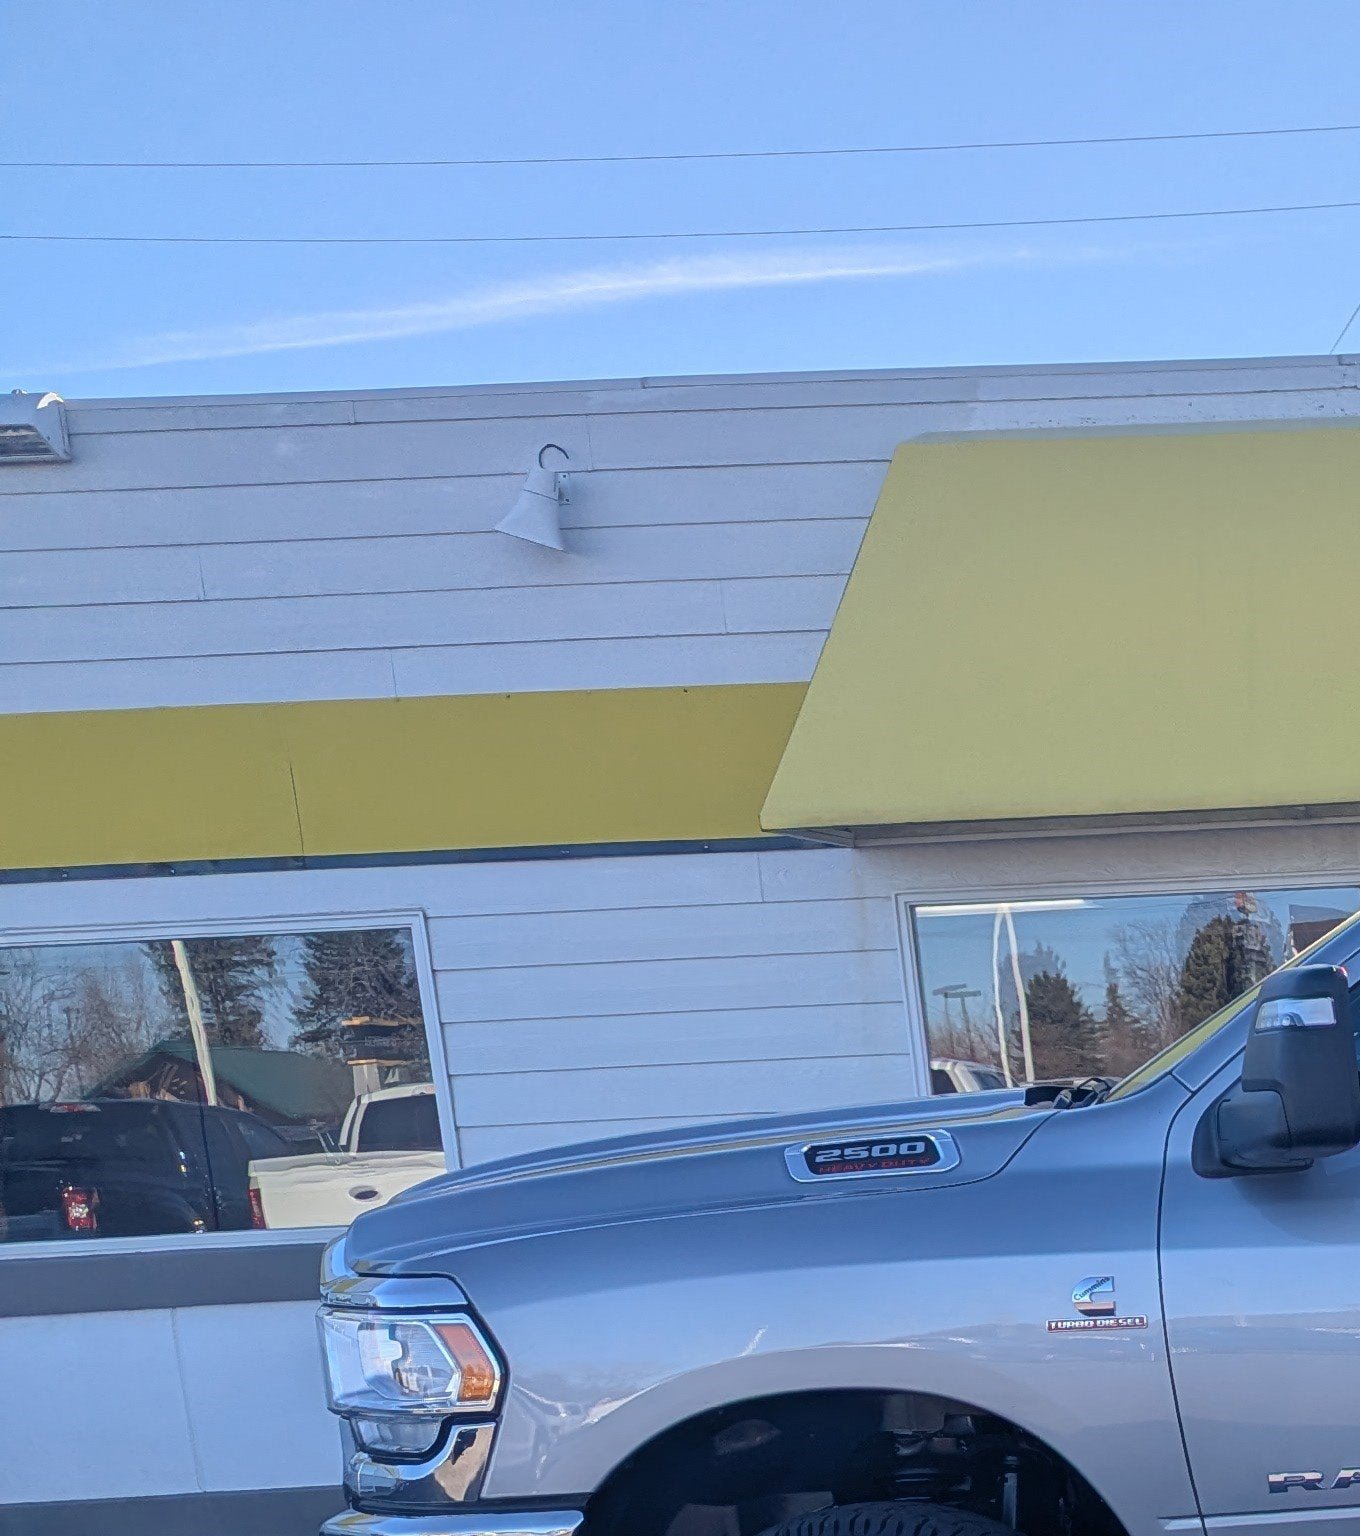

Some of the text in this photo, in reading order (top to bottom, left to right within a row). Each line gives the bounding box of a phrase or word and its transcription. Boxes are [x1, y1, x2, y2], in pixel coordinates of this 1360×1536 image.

[814, 1141, 926, 1163] 2500
[819, 1156, 931, 1174] HEAVY DUTY
[1073, 1276, 1111, 1301] Cummins
[1049, 1317, 1144, 1330] TURBO DIESEL
